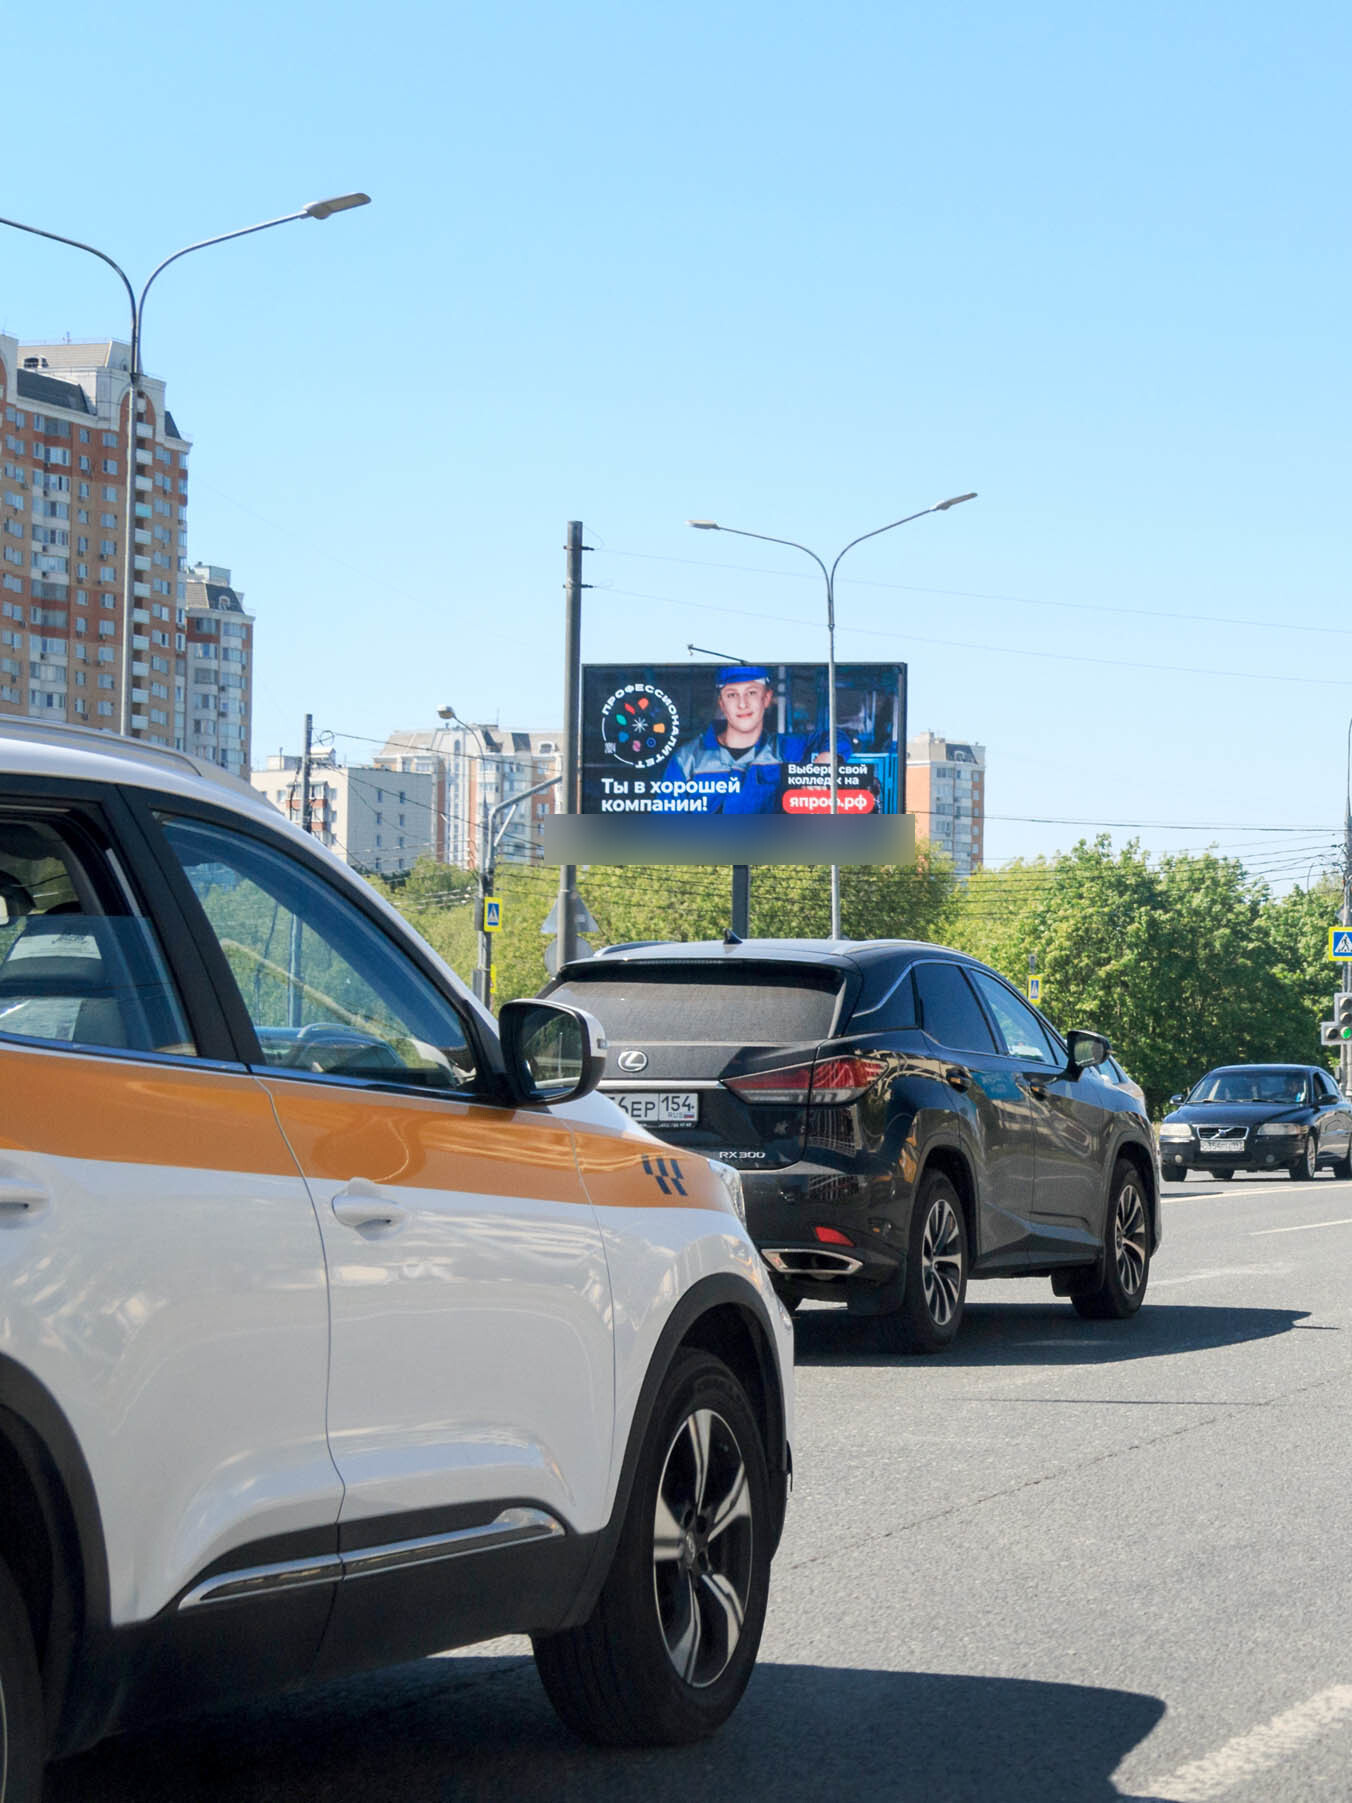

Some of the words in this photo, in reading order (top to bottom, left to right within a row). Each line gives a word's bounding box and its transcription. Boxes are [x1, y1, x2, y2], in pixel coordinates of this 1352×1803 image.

[602, 683, 680, 769] ПРОФЕССИОНАЛИТЕТ
[788, 764, 834, 776] Выбер
[838, 763, 868, 774] свой
[601, 778, 629, 794] Ты
[634, 780, 646, 794] в
[650, 777, 741, 797] хорошей
[844, 776, 860, 785] на
[601, 796, 708, 812] компании!
[661, 1095, 692, 1112] 154
